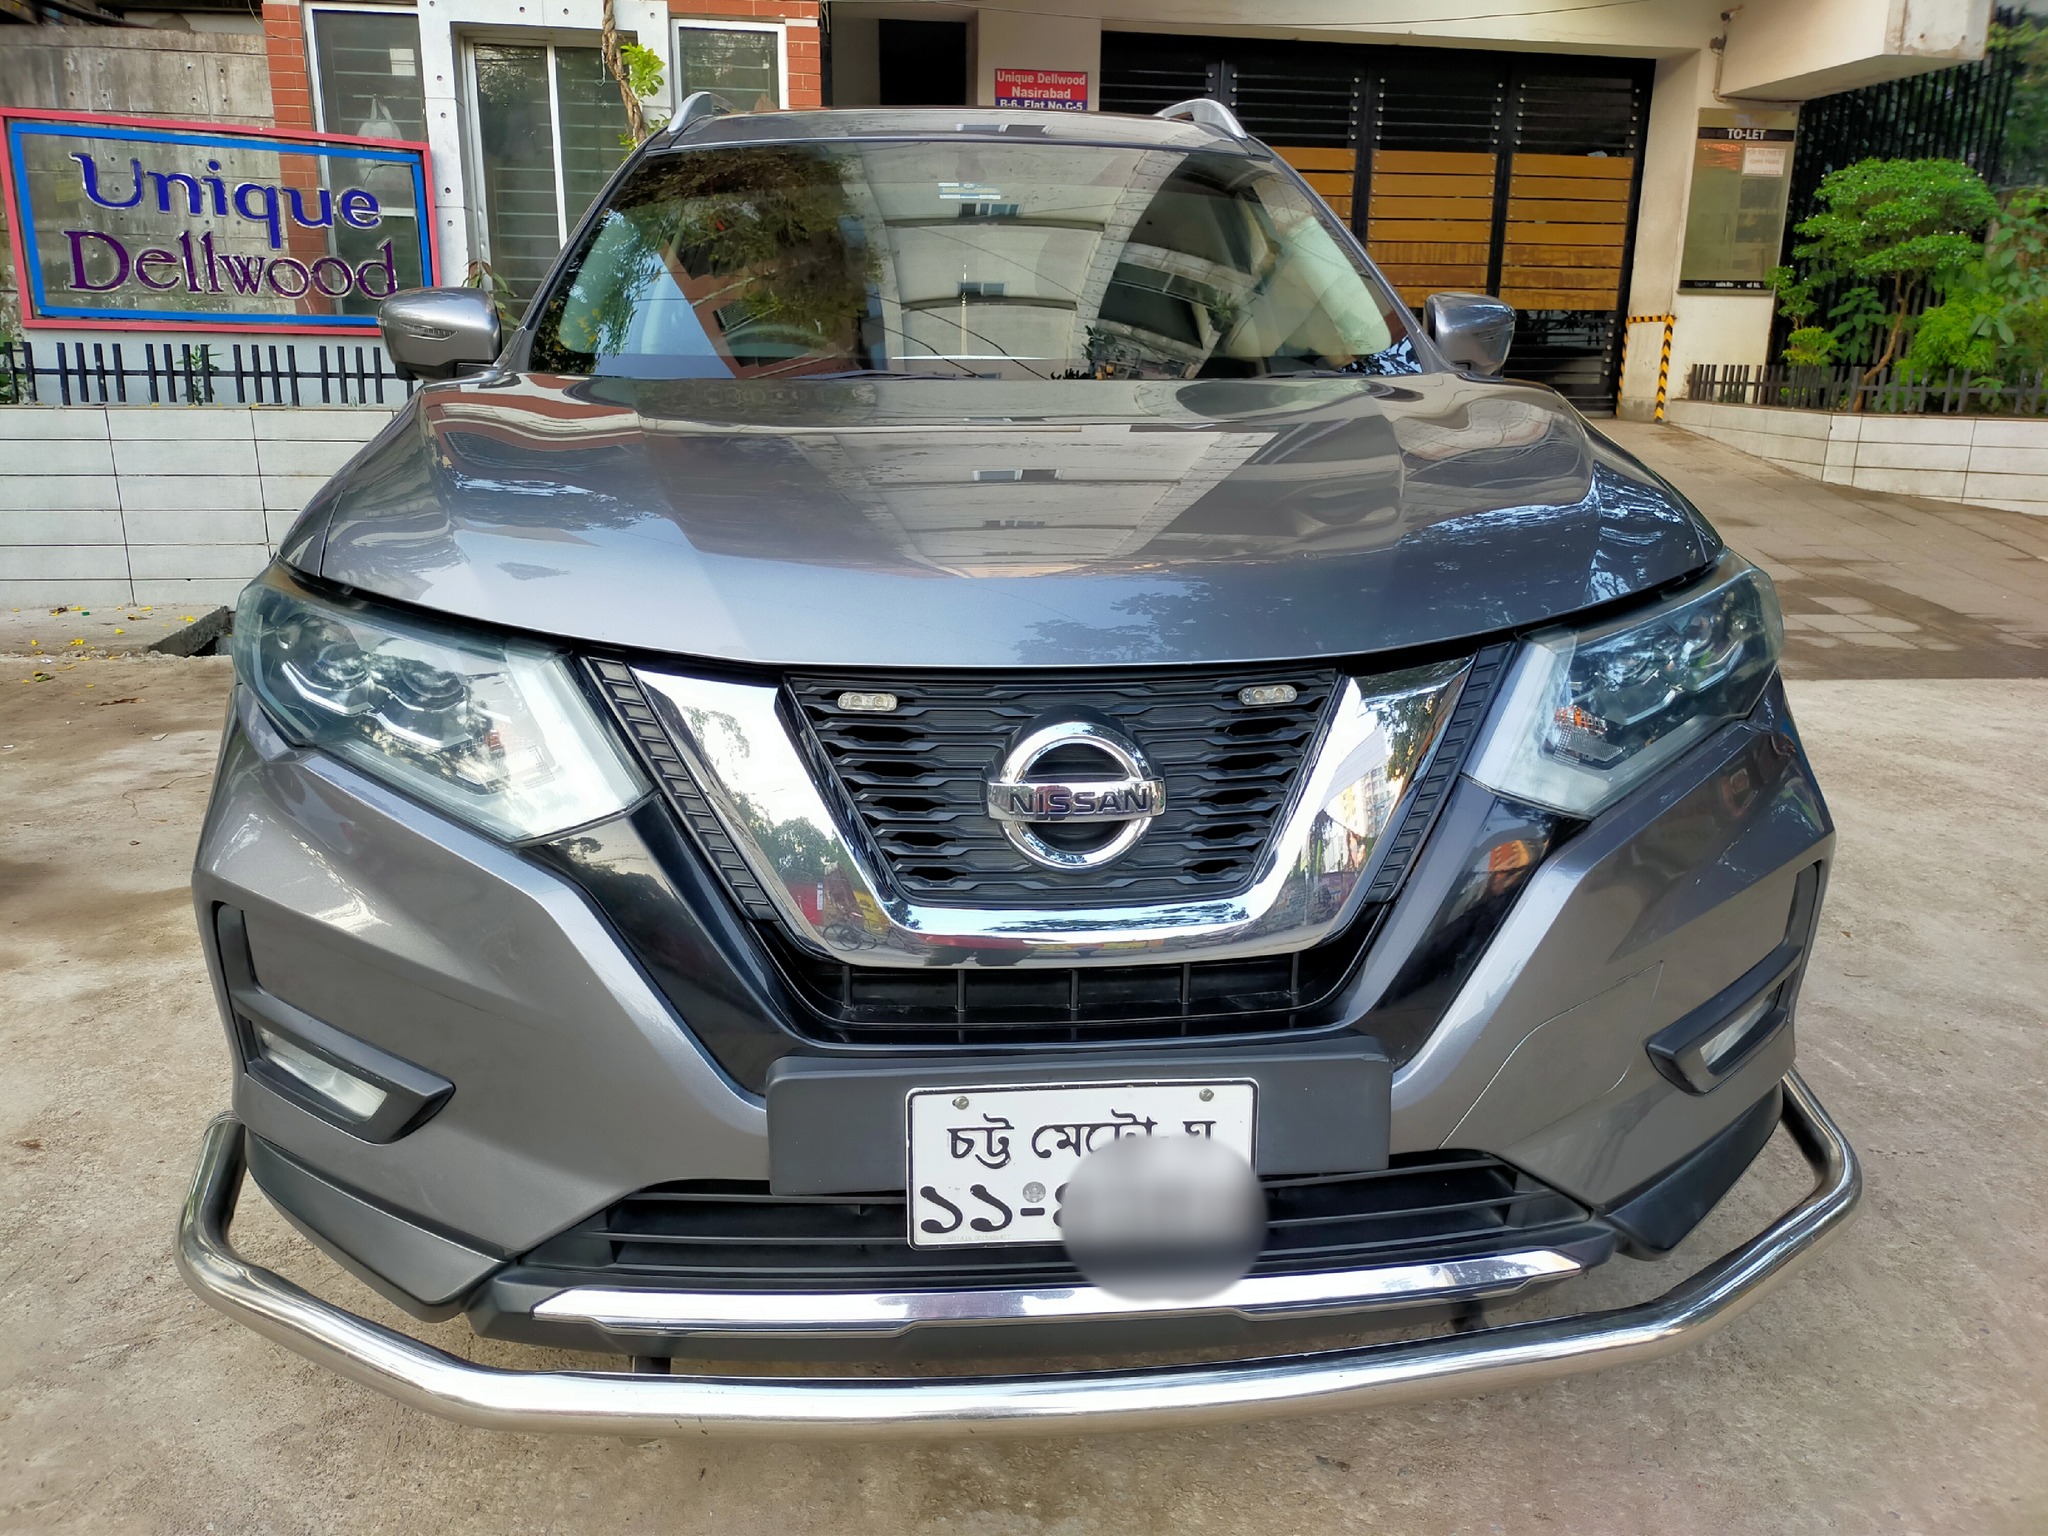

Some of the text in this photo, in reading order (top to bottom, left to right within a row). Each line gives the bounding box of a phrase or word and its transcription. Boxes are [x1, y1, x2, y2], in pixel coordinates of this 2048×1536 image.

[998, 70, 1086, 86] Unique Dellwood
[1011, 86, 1071, 99] Nasirabad
[1024, 100, 1045, 108] Flat
[1727, 128, 1766, 140] TO-LET
[70, 152, 382, 250] Unique
[63, 229, 398, 300] Dellwood
[1008, 789, 1149, 815] NISSAN
